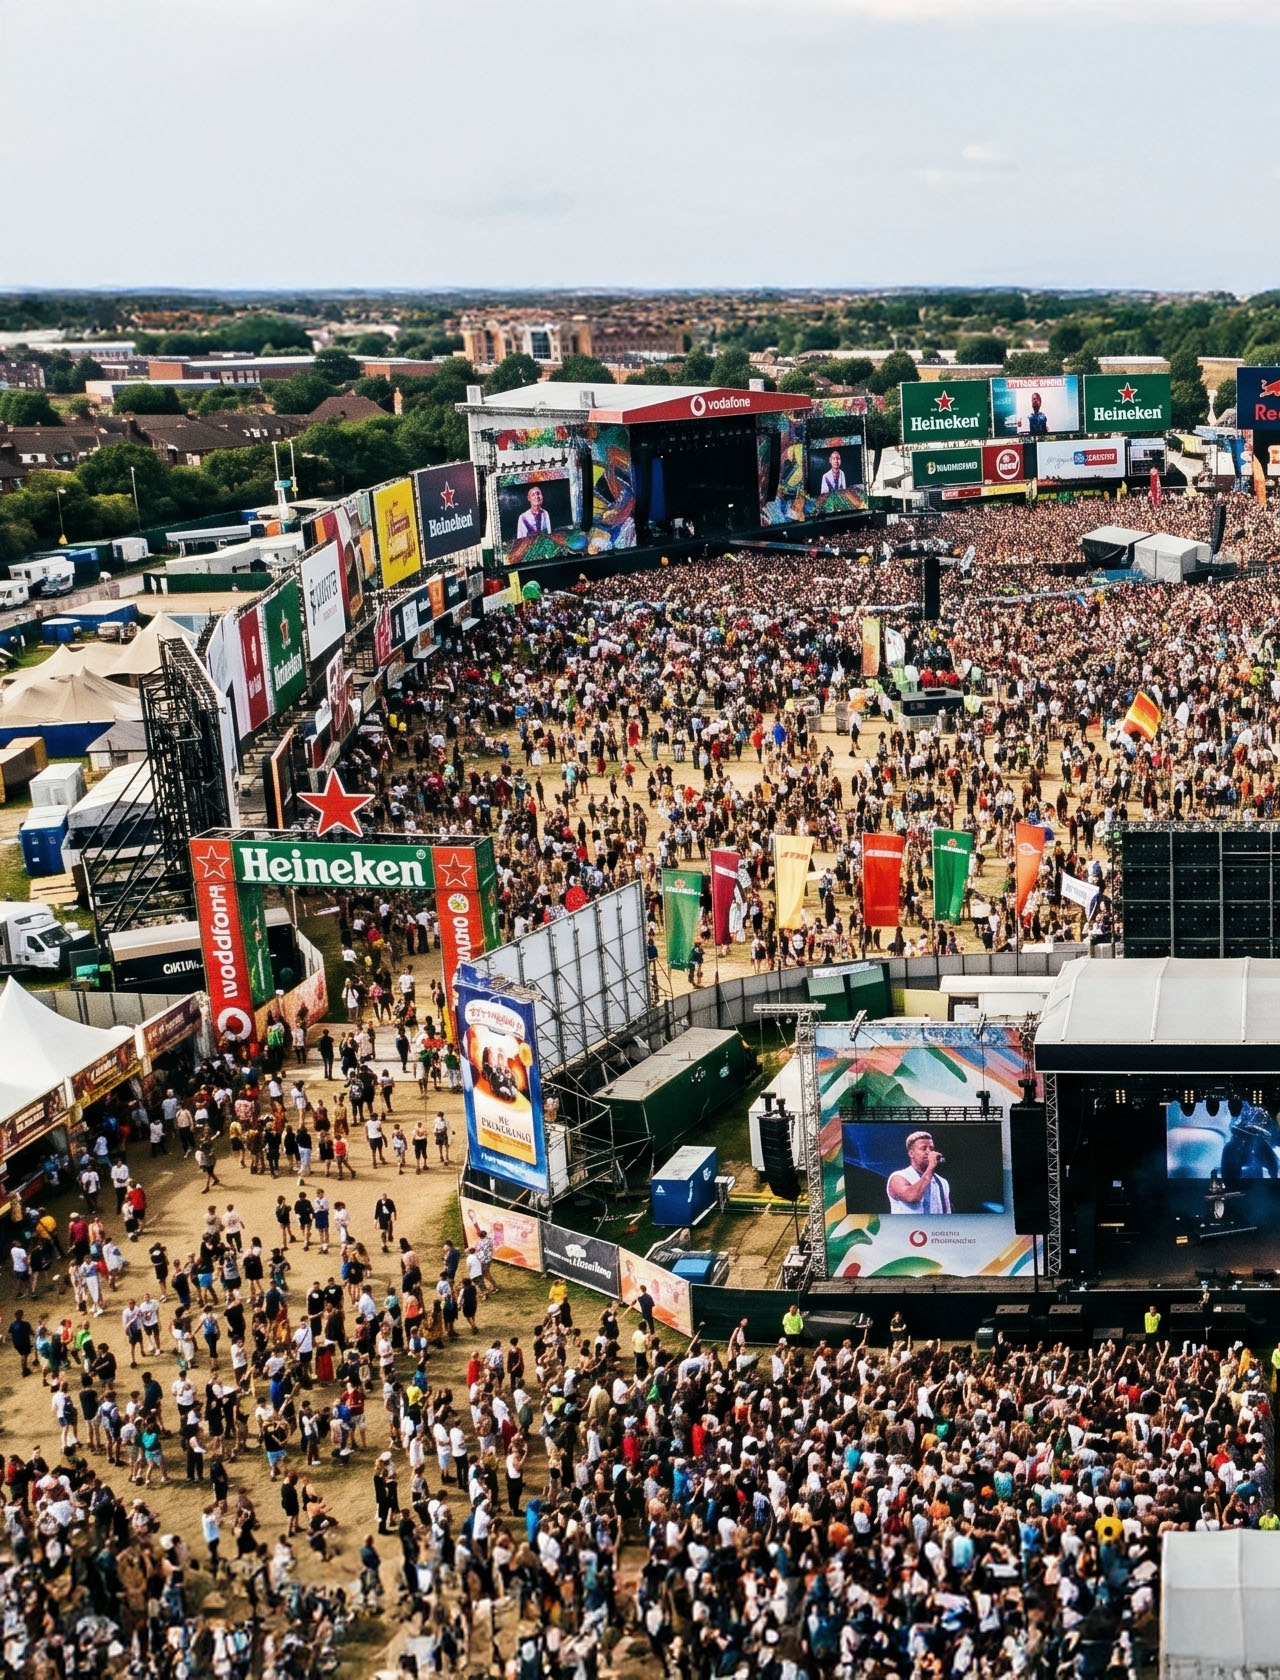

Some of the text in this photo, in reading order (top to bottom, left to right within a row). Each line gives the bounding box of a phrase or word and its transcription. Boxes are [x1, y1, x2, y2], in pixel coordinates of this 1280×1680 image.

[708, 396, 751, 410] vodafone
[911, 413, 980, 431] Heineken
[1093, 405, 1163, 421] Heineken
[428, 511, 474, 537] Heineken
[239, 847, 427, 888] Heineken
